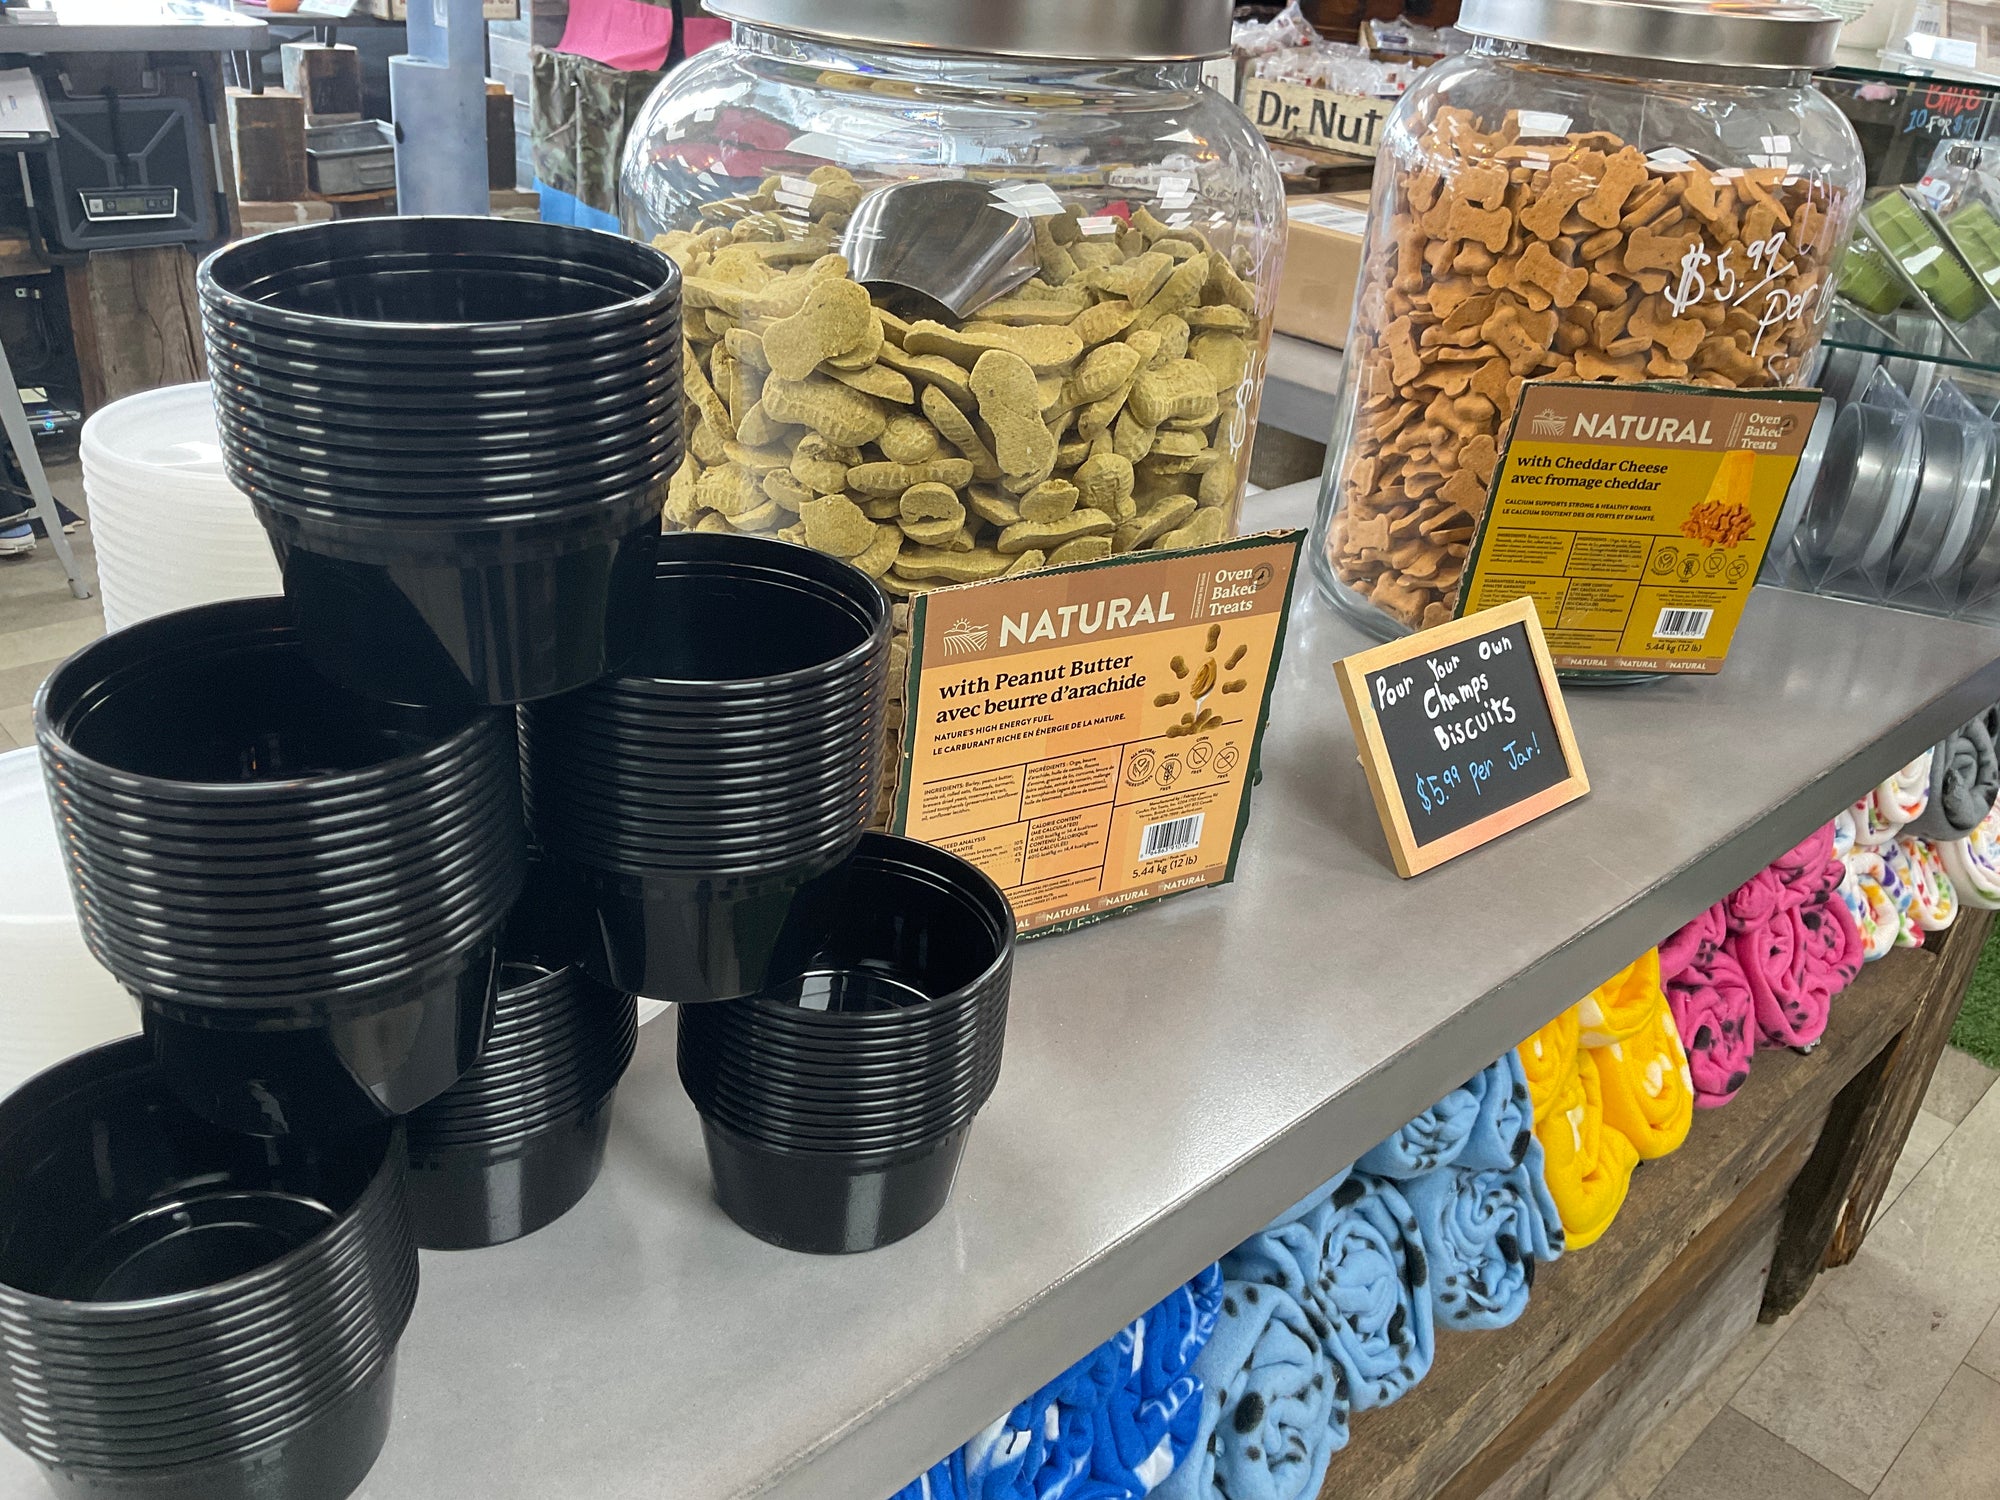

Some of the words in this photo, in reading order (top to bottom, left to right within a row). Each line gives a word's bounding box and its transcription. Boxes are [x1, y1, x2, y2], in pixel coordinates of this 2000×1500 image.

[1257, 90, 1300, 132] Dr.
[1309, 98, 1383, 146] Nut
[1904, 109, 1928, 133] 10
[1925, 115, 1952, 136] FOR
[1749, 413, 1781, 425] Oven
[1573, 413, 1713, 445] NATURAL
[1744, 426, 1784, 437] Baked
[1741, 438, 1778, 450] Treats
[1518, 455, 1551, 468] with
[1555, 457, 1616, 471] Cheddar
[1619, 460, 1668, 474] Cheese
[1511, 474, 1542, 484] avec
[1545, 474, 1602, 490] fromage
[1604, 477, 1661, 491] cheddar
[1215, 568, 1253, 583] Oven
[1212, 580, 1257, 600] Baked
[1209, 600, 1253, 616] Treats
[1000, 591, 1175, 648] NATURAL
[1645, 643, 1664, 651] 5.44
[1666, 643, 1676, 654] kg
[1678, 644, 1690, 652] (12
[1691, 643, 1702, 652] lb)
[1570, 659, 1608, 667] NATURAL
[1620, 660, 1657, 668] NATURAL
[1669, 662, 1706, 670] NATURAL
[939, 677, 989, 699] with
[995, 664, 1066, 690] Peanut
[1069, 655, 1133, 677] Butter
[1376, 675, 1414, 711] Pour
[1427, 654, 1460, 682] Your
[1478, 636, 1513, 661] Own
[1423, 672, 1489, 719] Champs
[936, 704, 980, 723] avec
[984, 692, 1048, 715] beurre
[976, 725, 997, 734] HIGH
[1000, 718, 1032, 730] ENERGY
[1434, 695, 1516, 751] Biscuits
[932, 746, 943, 755] LE
[944, 738, 995, 754] CARBURANT
[997, 732, 1022, 742] RICHE
[1023, 730, 1034, 738] EN
[1036, 724, 1070, 736] ÉNERGIE
[1071, 721, 1082, 729] DE
[1416, 765, 1461, 815] $5.99
[1503, 731, 1541, 771] Jar!
[1132, 866, 1154, 878] 5.44
[1157, 864, 1167, 875] kg
[1170, 859, 1183, 870] (12
[1185, 855, 1198, 864] lb)
[1163, 874, 1206, 891] NATURAL
[1106, 888, 1149, 906] NATURAL
[1045, 903, 1090, 922] NATURAL
